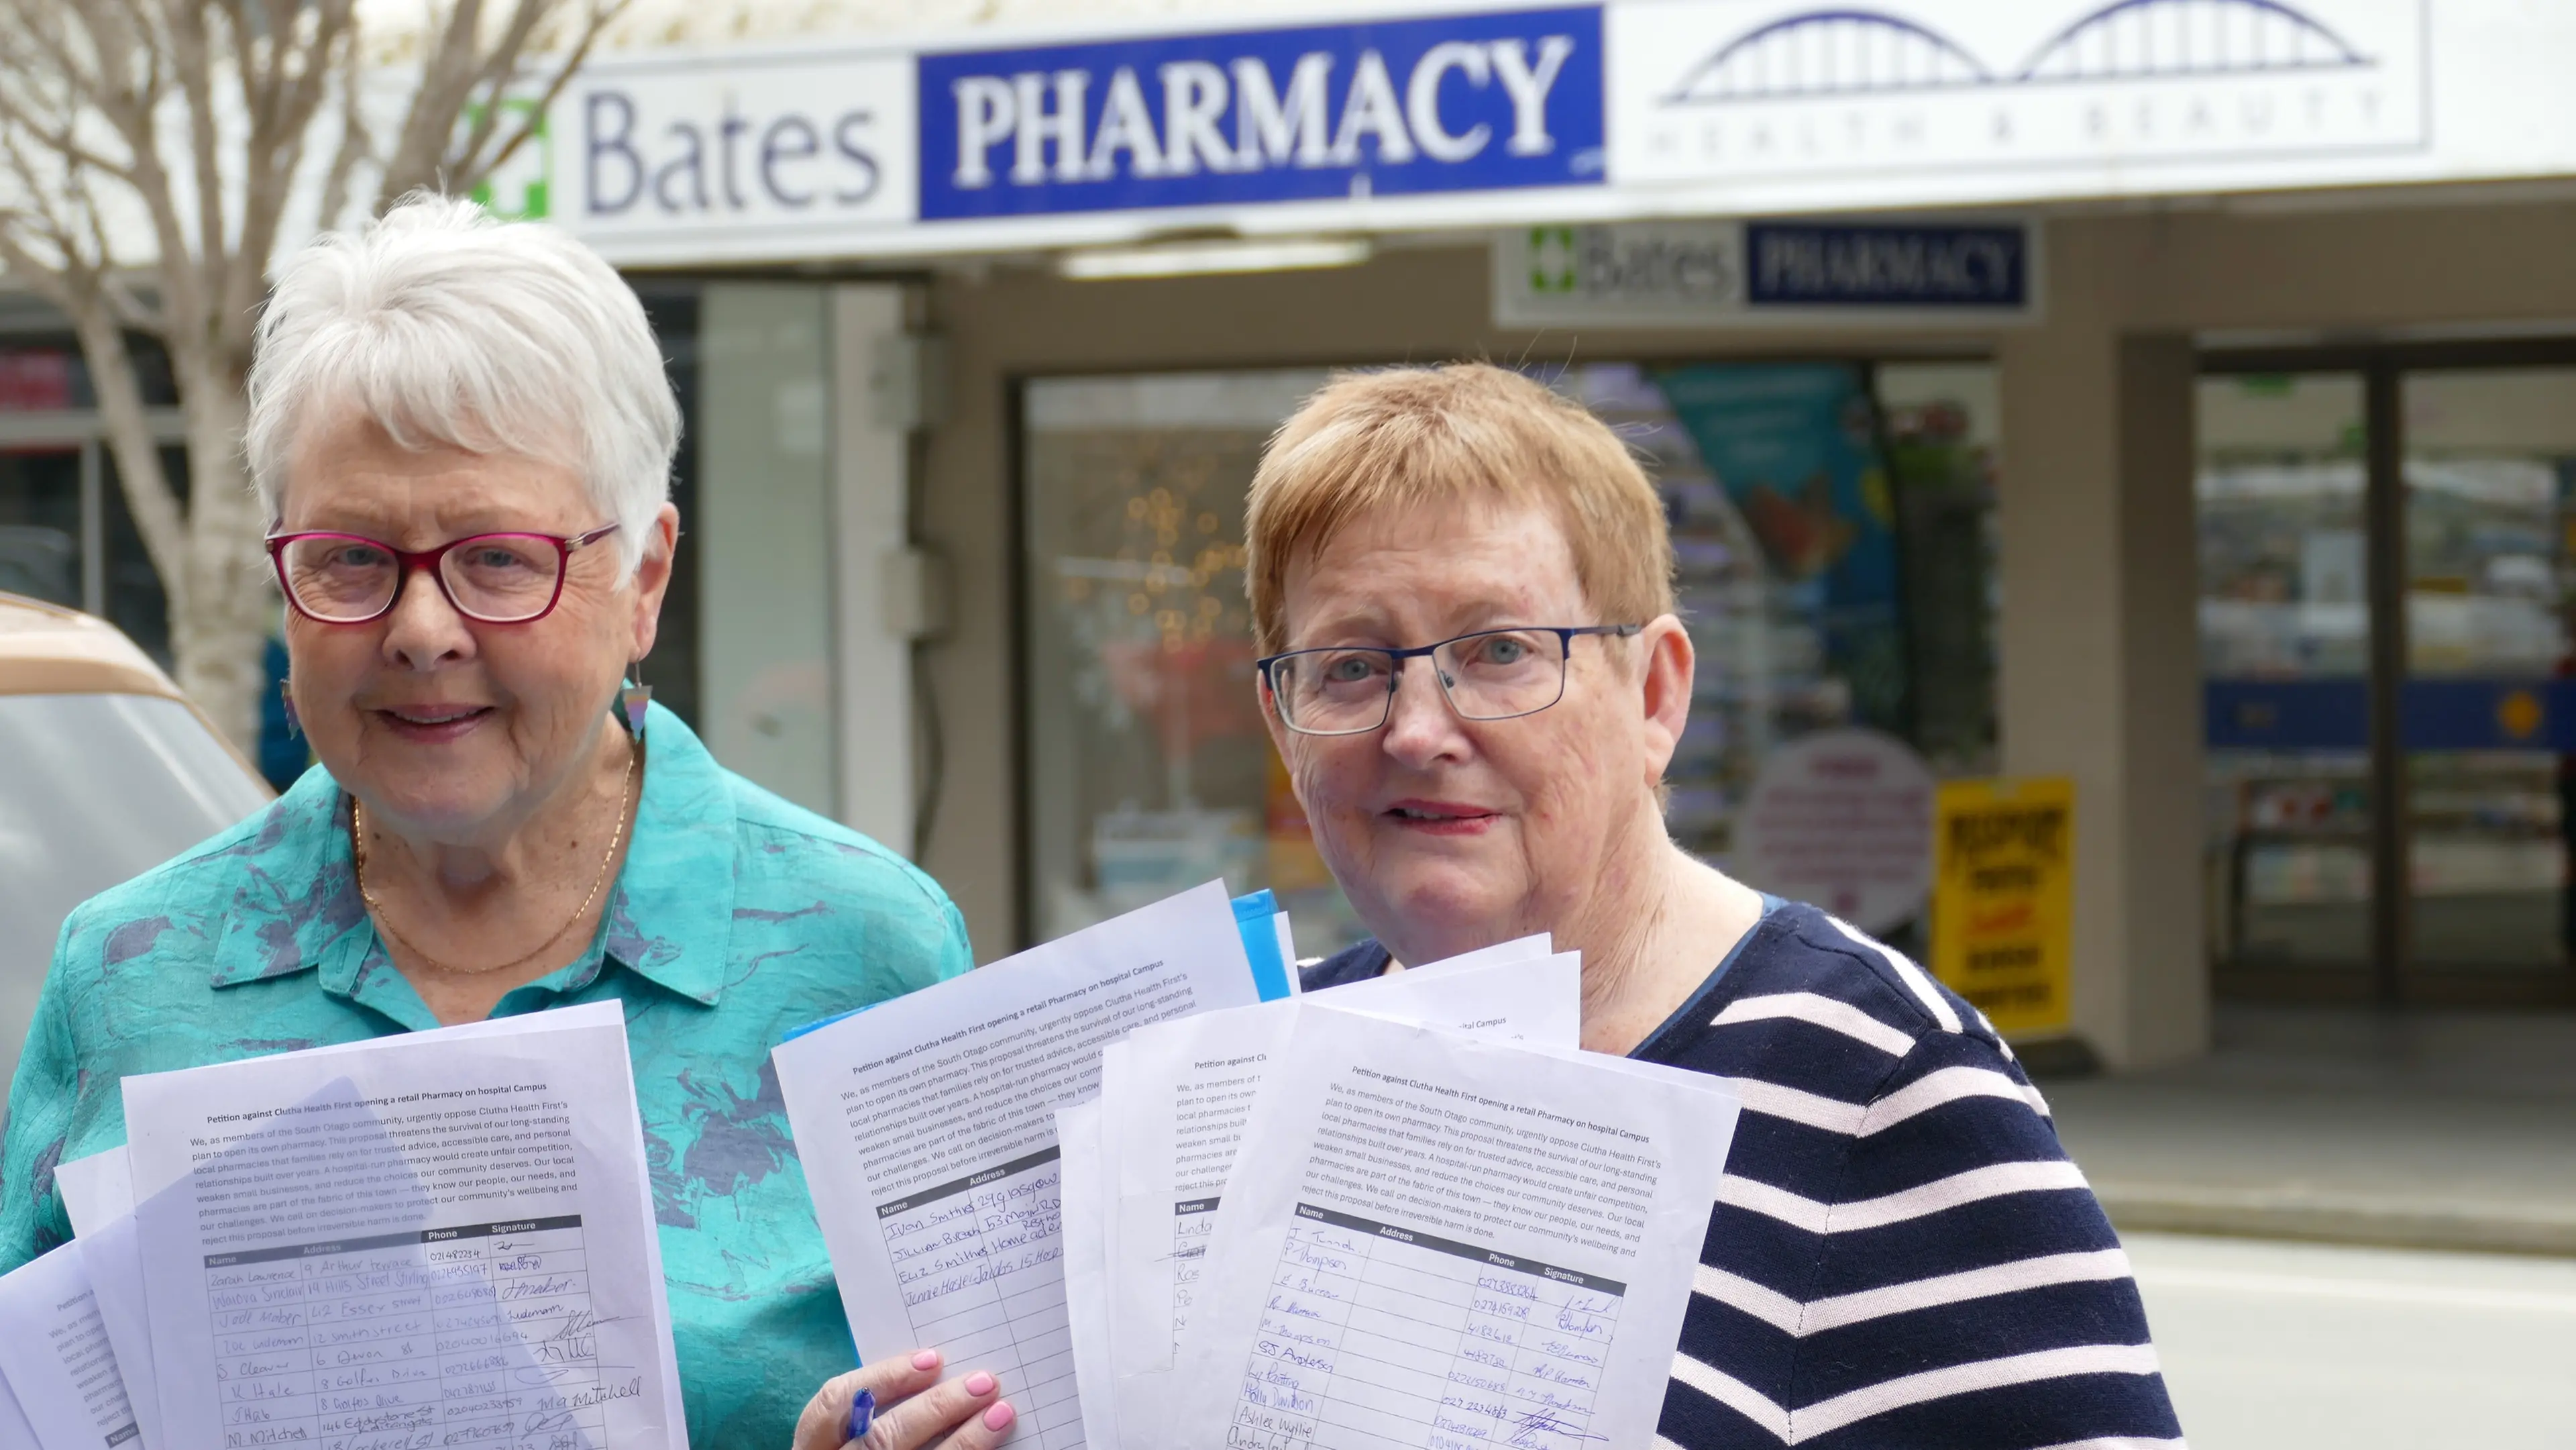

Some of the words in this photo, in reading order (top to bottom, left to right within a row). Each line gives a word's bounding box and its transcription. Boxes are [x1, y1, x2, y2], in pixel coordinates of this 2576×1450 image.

[585, 86, 881, 215] Bates
[953, 36, 1573, 190] PHARMACY
[1646, 111, 1927, 161] HEALTH
[1988, 107, 2015, 145] &
[2083, 87, 2385, 139] BEAUTY
[1760, 234, 2015, 295] PHARMACY
[852, 1059, 883, 1075] Petition
[885, 1048, 913, 1064] against
[914, 1040, 940, 1053] Clutha
[940, 1029, 967, 1044] Health
[967, 1023, 985, 1034] First
[986, 1012, 1019, 1028] opening
[1026, 1000, 1047, 1014] retail
[1047, 987, 1086, 1006] Pharmacy
[1087, 983, 1099, 992] on
[1099, 970, 1131, 987] hospital
[1132, 960, 1164, 976] Campus
[1476, 1017, 1507, 1029] Campus
[840, 1091, 858, 1100] We,
[859, 1086, 870, 1095] as
[871, 1072, 910, 1090] members
[911, 1066, 920, 1076] of
[921, 1063, 935, 1073] the
[936, 1053, 962, 1068] South
[962, 1045, 988, 1058] Otago
[989, 1027, 1037, 1049] community,
[1038, 1015, 1071, 1032] urgently
[1073, 1003, 1104, 1019] oppose
[1104, 992, 1132, 1008] Clutha
[1133, 982, 1162, 997] Health
[1195, 1058, 1225, 1069] Petition
[1228, 1055, 1255, 1067] against
[207, 1113, 240, 1123] Petition
[242, 1109, 272, 1121] against
[274, 1106, 302, 1116] Clutha
[303, 1102, 332, 1112] Health
[333, 1100, 352, 1109] First
[354, 1097, 388, 1108] opening
[397, 1092, 419, 1102] retail
[421, 1090, 463, 1100] Pharmacy
[477, 1084, 511, 1096] hospital
[513, 1084, 547, 1092] Campus
[1177, 1084, 1192, 1092] We,
[1206, 1078, 1245, 1089] members
[1247, 1075, 1255, 1083] of
[1177, 1097, 1194, 1108] plan
[1196, 1096, 1204, 1104] to
[1206, 1094, 1226, 1104] open
[1228, 1092, 1238, 1100] its
[1352, 1066, 1381, 1079] Petition
[1381, 1074, 1408, 1086] against
[1409, 1079, 1433, 1092] Clutha
[1434, 1085, 1459, 1098] Health
[1460, 1091, 1477, 1102] First
[1478, 1097, 1509, 1111] opening
[1515, 1106, 1536, 1116] retail
[1536, 1109, 1574, 1127] Pharmacy
[1587, 1121, 1618, 1135] hospital
[1619, 1129, 1649, 1143] Campus
[1177, 1111, 1196, 1121] local
[1198, 1105, 1245, 1119] pharmacies
[1330, 1082, 1344, 1094] We,
[1346, 1088, 1356, 1096] as
[1357, 1090, 1393, 1104] members
[1395, 1099, 1403, 1107] of
[1404, 1100, 1417, 1110] the
[1418, 1103, 1442, 1117] South
[1444, 1109, 1467, 1123] Otago
[1468, 1117, 1513, 1135] community,
[1515, 1129, 1548, 1143] urgently
[1548, 1136, 1578, 1149] oppose
[1580, 1142, 1607, 1156] Clutha
[1608, 1149, 1635, 1163] Health
[871, 1182, 895, 1196] reject
[895, 1177, 912, 1188] this
[912, 1163, 949, 1184] proposal
[949, 1155, 977, 1170] before
[977, 1139, 1023, 1160] irreversible
[1023, 1131, 1046, 1144] harm
[1045, 1128, 1055, 1136] is
[1325, 1097, 1343, 1108] plan
[1343, 1102, 1352, 1110] to
[1352, 1104, 1373, 1115] open
[1373, 1109, 1383, 1117] its
[1384, 1112, 1401, 1122] own
[1401, 1117, 1441, 1133] pharmacy.
[1444, 1125, 1460, 1136] This
[1459, 1131, 1495, 1145] proposal
[1495, 1138, 1532, 1154] threatens
[1533, 1147, 1546, 1157] the
[1547, 1151, 1578, 1165] survival
[1578, 1158, 1589, 1167] of
[1588, 1161, 1603, 1170] our
[1603, 1162, 1658, 1186] long-standing
[196, 1193, 231, 1202] weaken
[232, 1188, 258, 1199] small
[314, 1180, 331, 1190] and
[333, 1177, 364, 1187] reduce
[366, 1175, 381, 1184] the
[383, 1172, 418, 1182] choices
[420, 1170, 435, 1178] our
[437, 1163, 487, 1176] community
[533, 1157, 550, 1166] Our
[552, 1155, 574, 1164] local
[881, 1202, 907, 1215] Name
[969, 1170, 1005, 1186] Address
[269, 1214, 284, 1223] We
[286, 1211, 303, 1221] call
[319, 1202, 392, 1217] decision-makers
[406, 1196, 438, 1208] protect
[440, 1195, 455, 1203] our
[517, 1184, 559, 1195] wellbeing
[560, 1182, 578, 1192] and
[1179, 1202, 1204, 1212] Name
[209, 1256, 236, 1265] Name
[303, 1245, 341, 1254] Address
[428, 1231, 457, 1240] Phone
[492, 1223, 535, 1233] Signature
[1299, 1206, 1323, 1219] Name
[1379, 1226, 1413, 1241] Address
[1489, 1253, 1514, 1266] Phone
[1544, 1267, 1583, 1284] Signature
[56, 1291, 88, 1312] Petition
